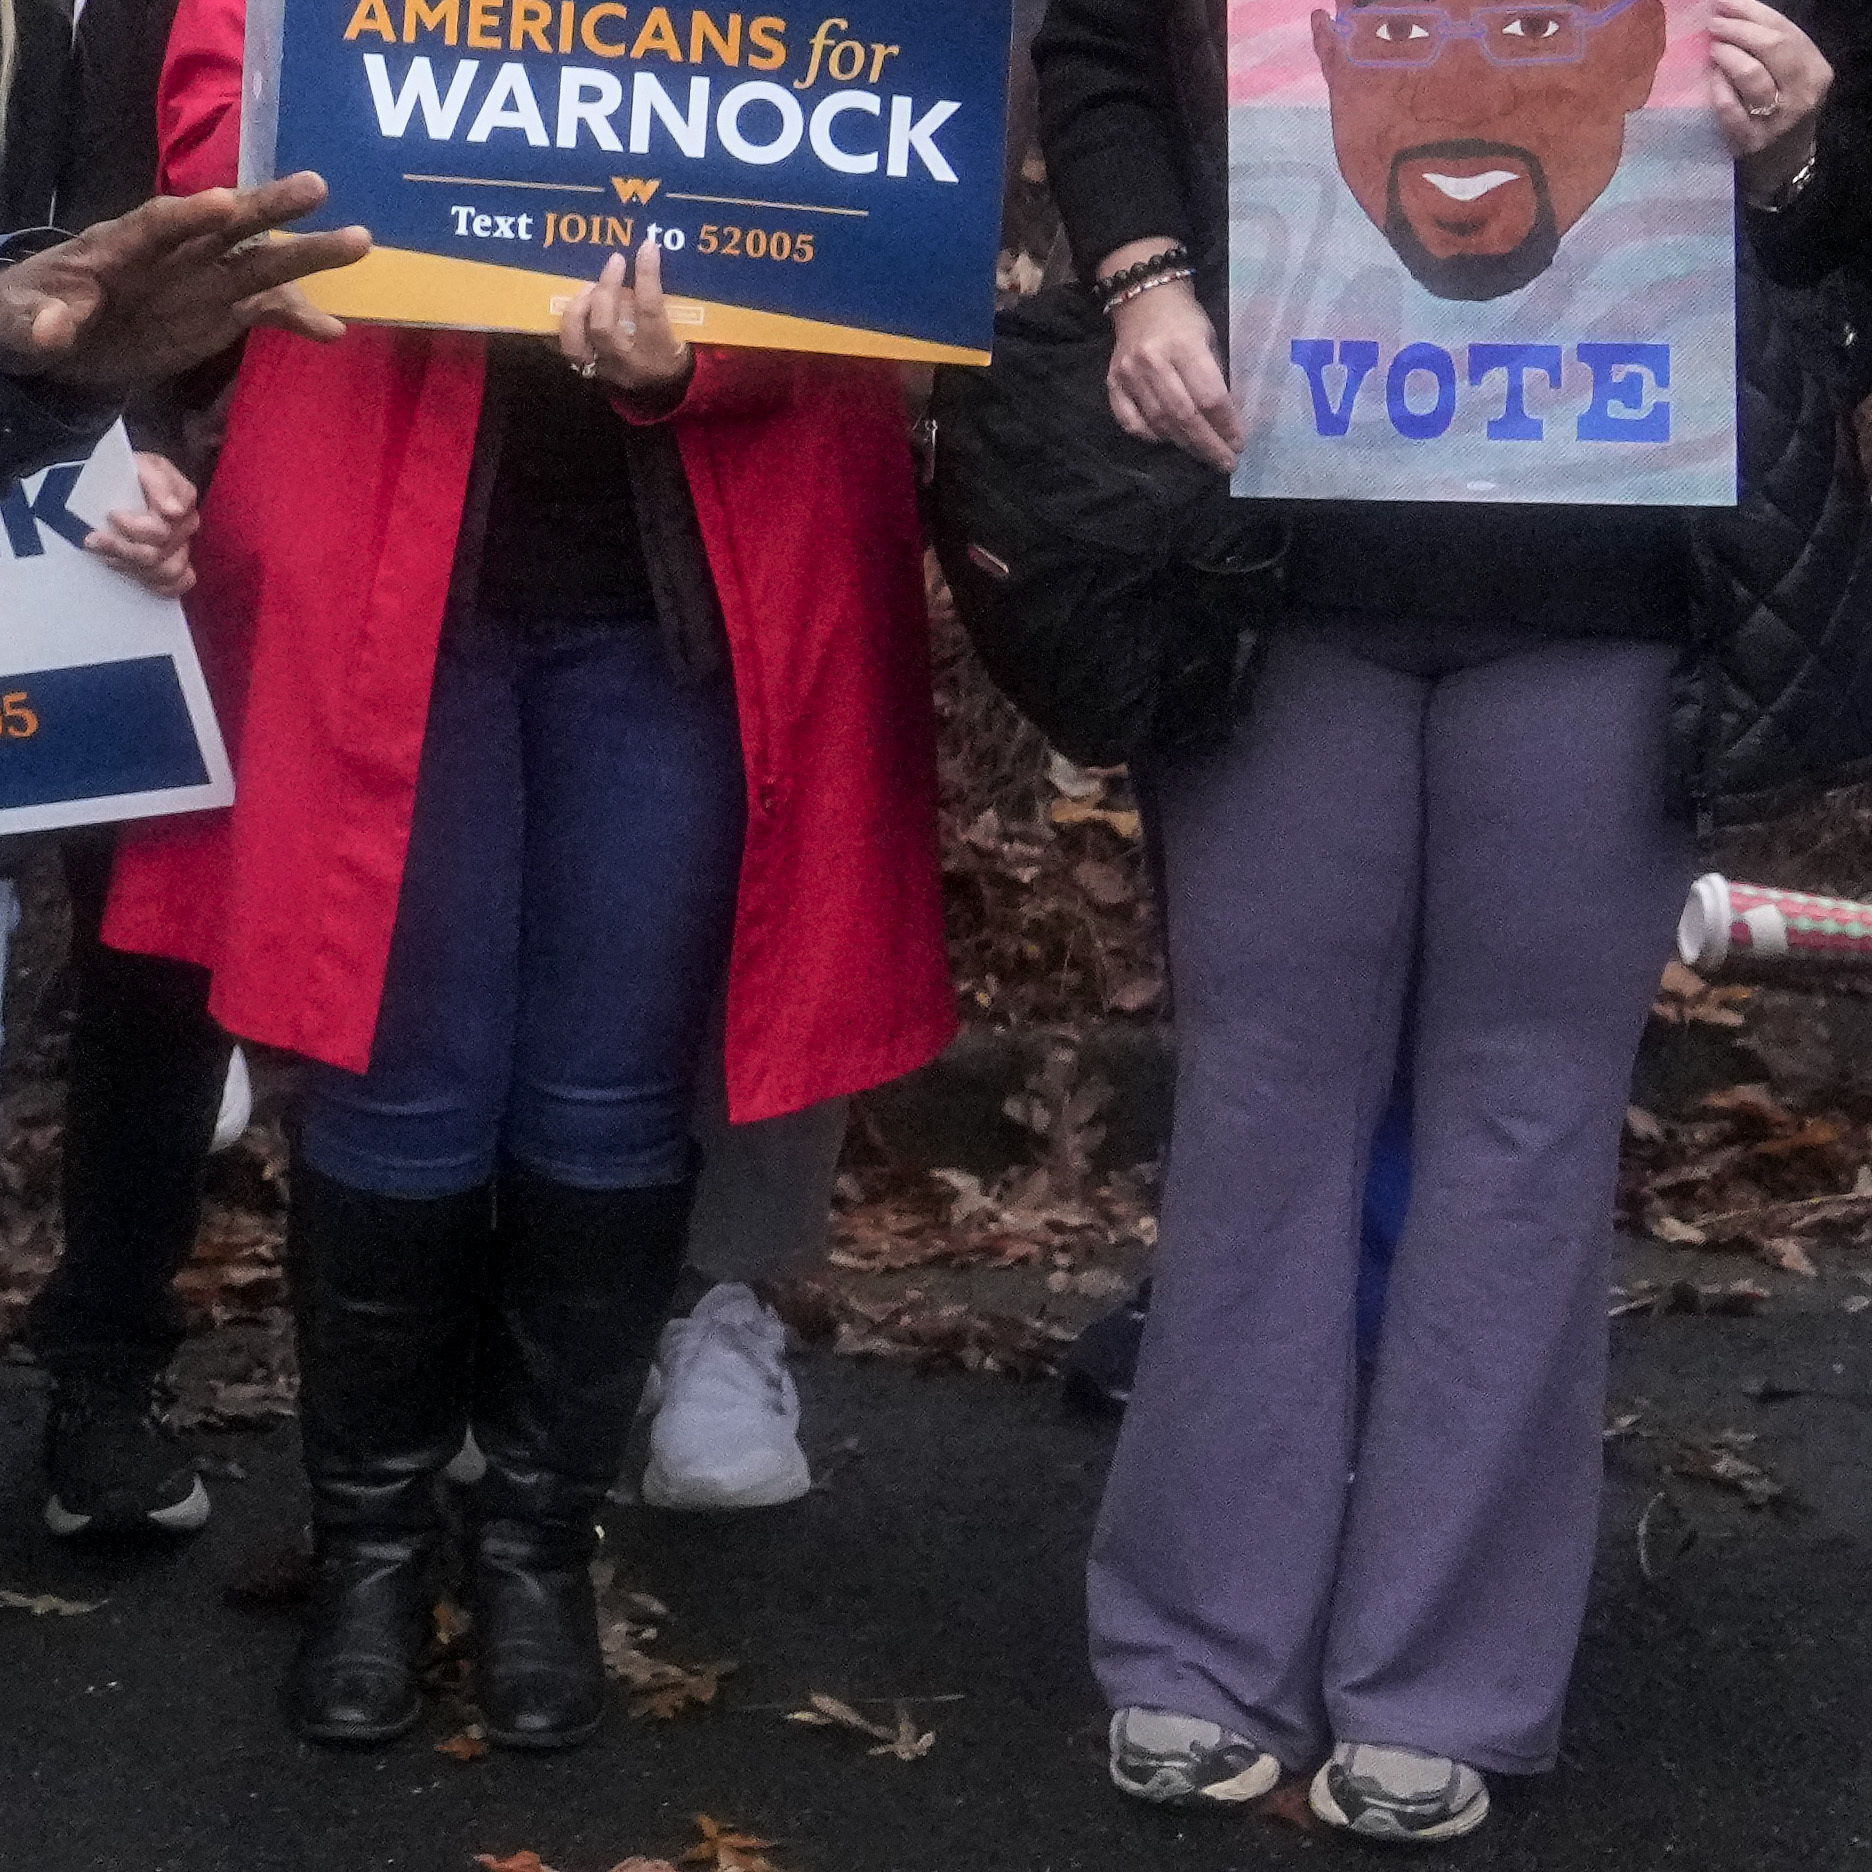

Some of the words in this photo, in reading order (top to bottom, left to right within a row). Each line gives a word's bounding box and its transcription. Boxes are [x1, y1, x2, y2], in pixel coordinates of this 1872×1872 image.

[792, 16, 900, 90] for
[363, 51, 963, 186] WARNOCK
[450, 203, 534, 244] Text
[542, 209, 634, 250] JOIN
[647, 217, 686, 252] to
[696, 222, 816, 266] 52005
[1290, 339, 1673, 444] VOTE
